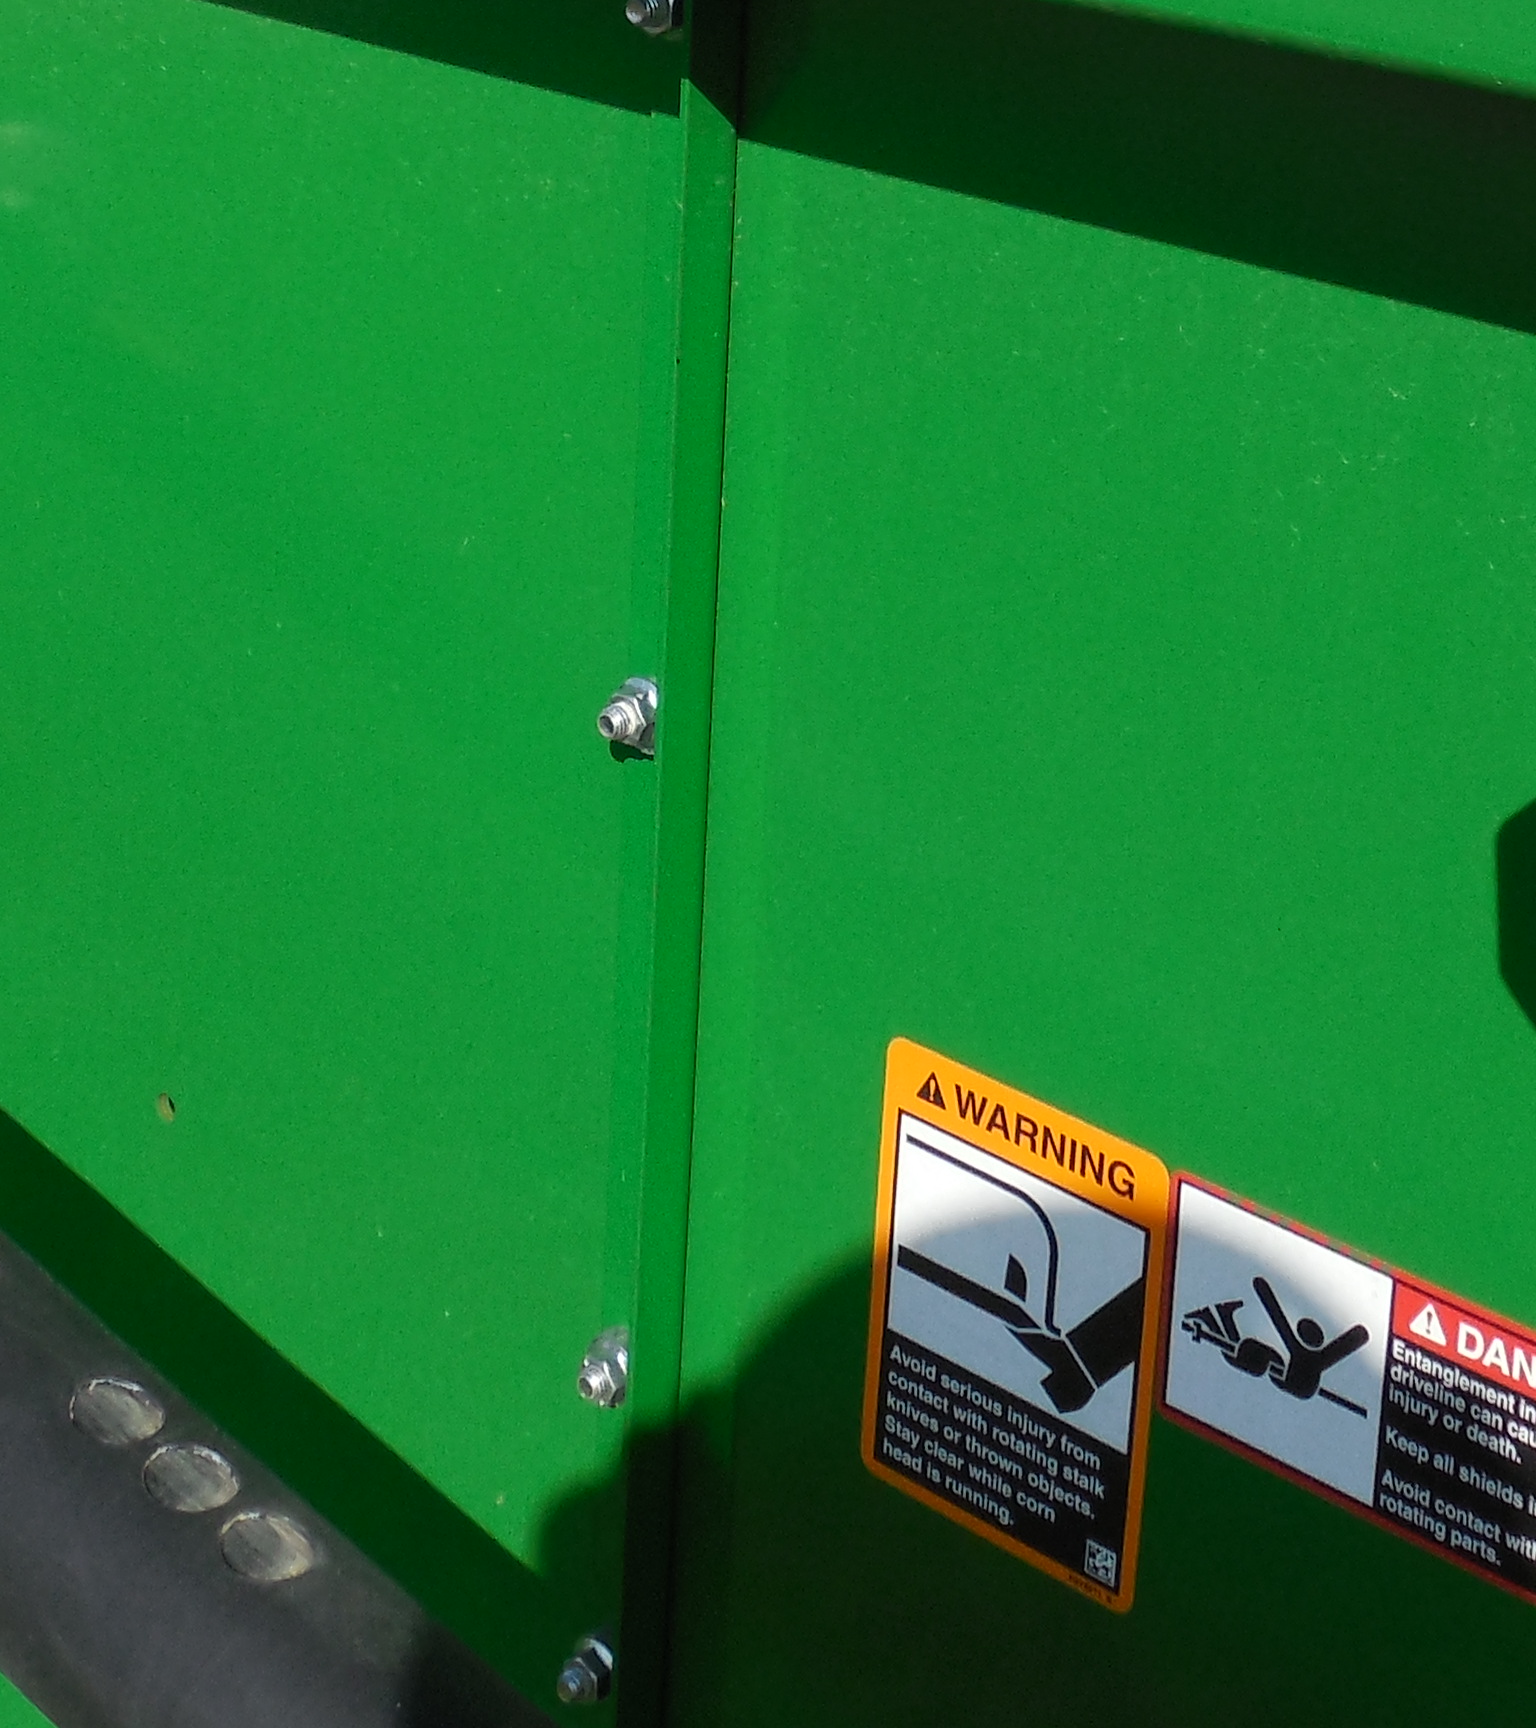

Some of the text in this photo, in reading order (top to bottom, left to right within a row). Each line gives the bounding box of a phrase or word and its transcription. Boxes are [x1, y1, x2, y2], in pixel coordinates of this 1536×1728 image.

[954, 1083, 1136, 1202] WARNING
[890, 1345, 1101, 1470] Avoid serious injury from
[1390, 1364, 1465, 1413] driveline
[1471, 1405, 1503, 1432] can
[1393, 1339, 1516, 1415] Entanglement
[1519, 1399, 1536, 1423] in
[887, 1391, 1095, 1519] knives or thrown objects.
[888, 1371, 1105, 1499] contact with rotating stalk
[1385, 1425, 1429, 1465] Keep
[1434, 1452, 1454, 1476] all
[1459, 1464, 1524, 1510] shields
[1388, 1384, 1522, 1465] injury or death.
[883, 1438, 1014, 1526] head is running.
[885, 1414, 1056, 1523] Stay clear while corn
[1382, 1469, 1430, 1509] Avoid
[1435, 1497, 1501, 1543] contact
[1379, 1492, 1501, 1567] rotating parts.
